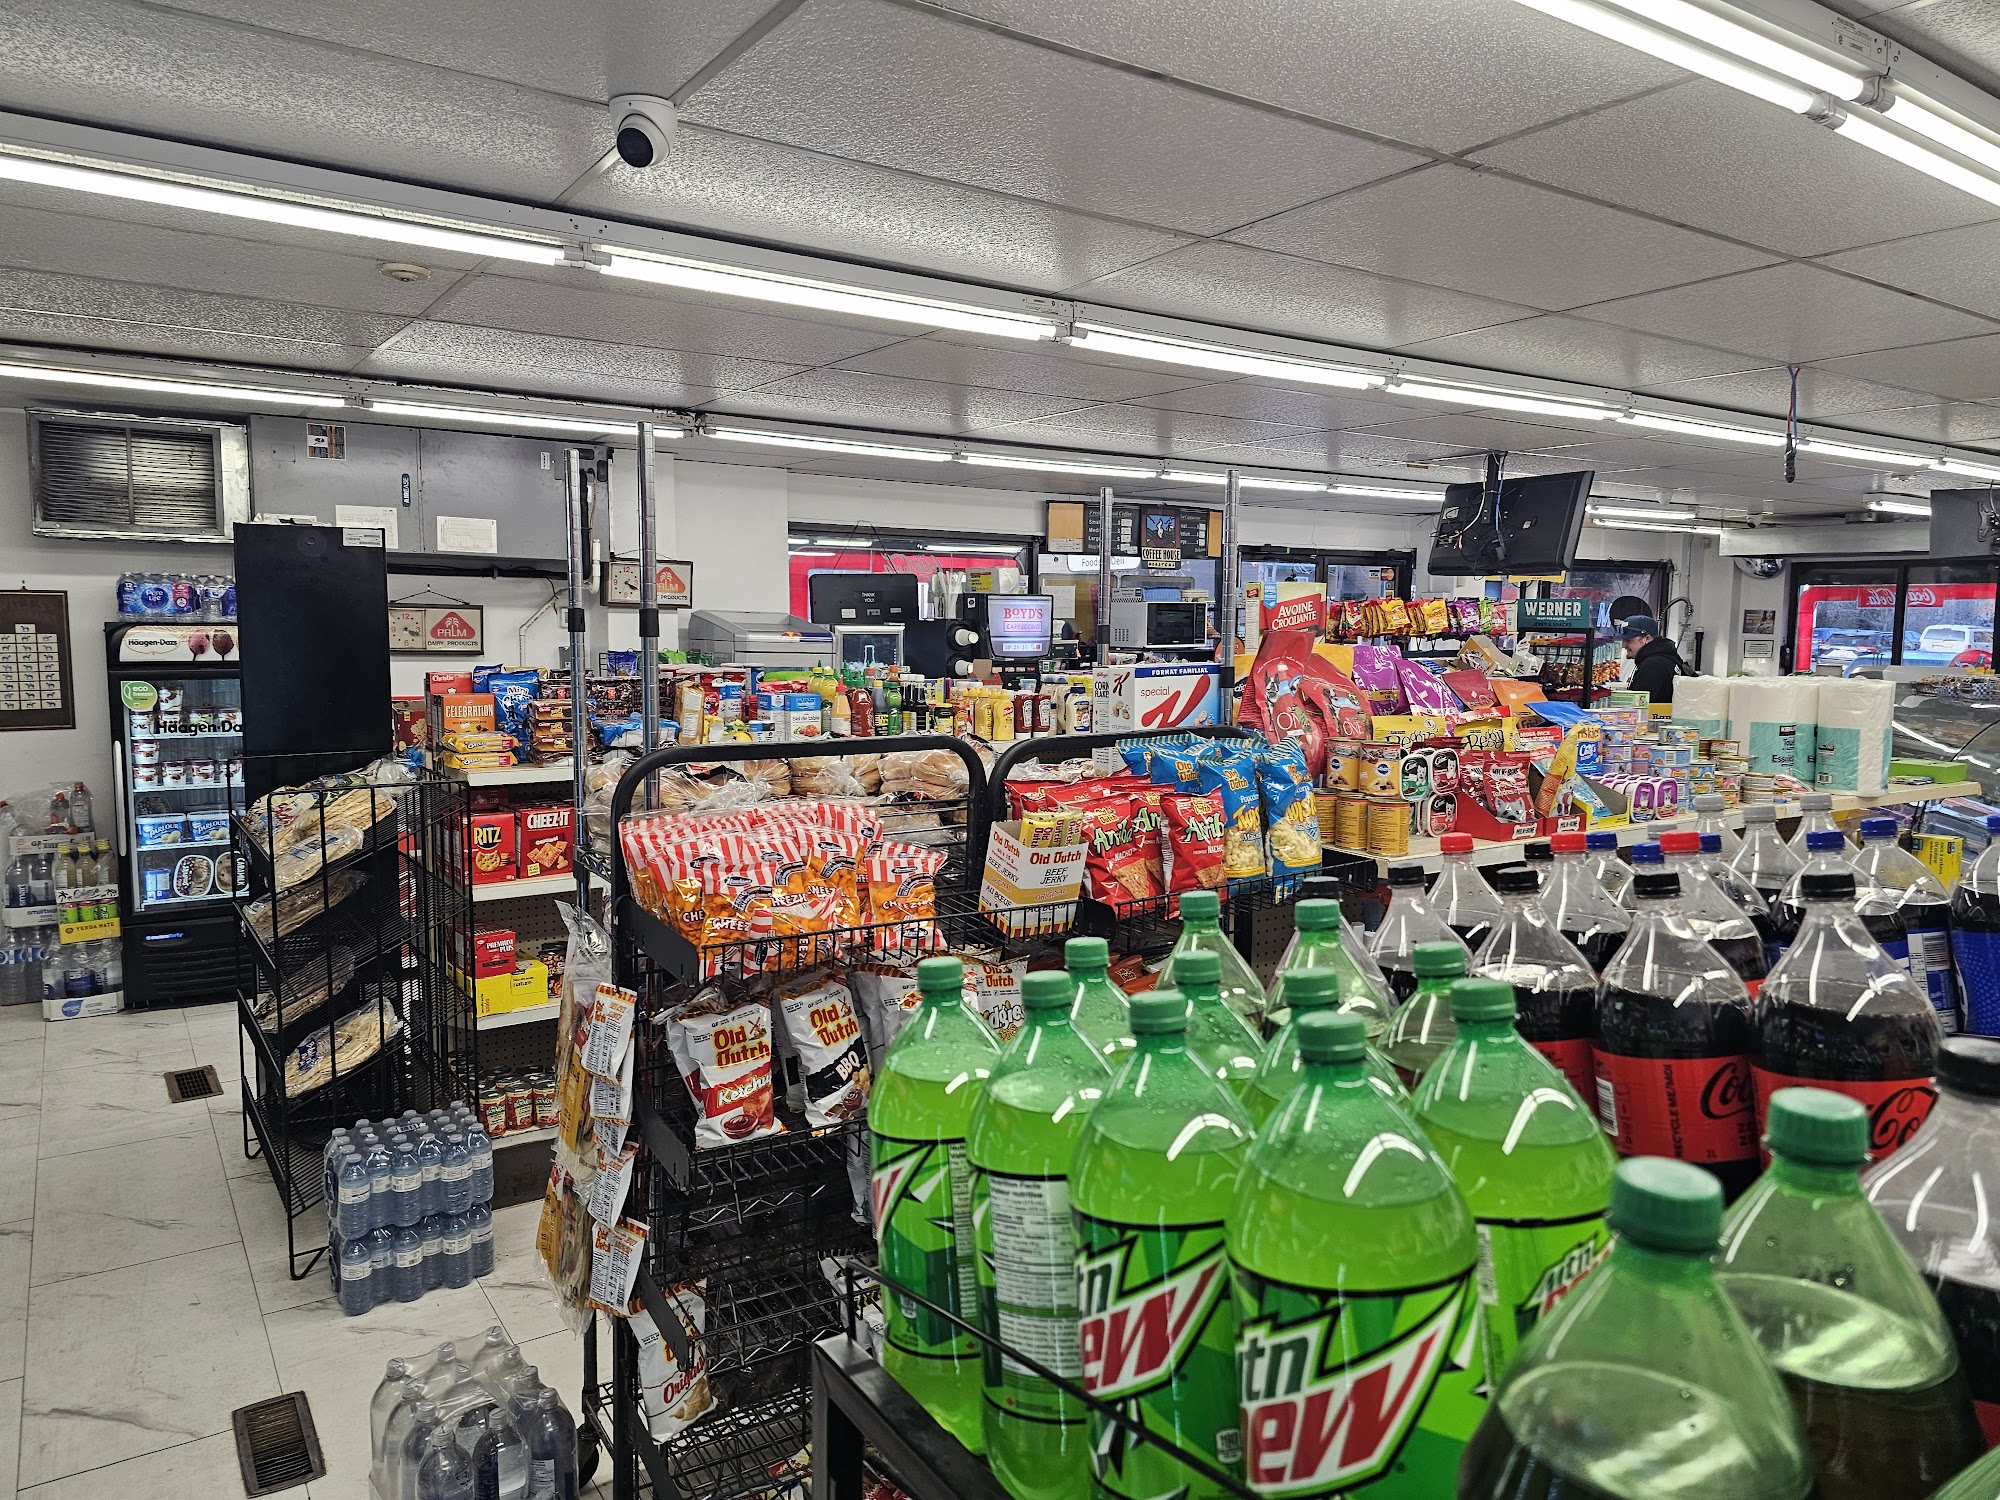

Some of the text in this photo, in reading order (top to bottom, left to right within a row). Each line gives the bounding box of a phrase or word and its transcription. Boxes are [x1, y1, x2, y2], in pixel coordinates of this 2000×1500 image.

[1111, 556, 1125, 566] Deli
[1142, 548, 1180, 560] COFFEE HOUSE
[1003, 607, 1043, 619] BOYD'S
[1277, 600, 1314, 619] AVOINE
[1524, 601, 1582, 616] WERNER
[401, 612, 410, 620] 12
[1271, 610, 1317, 631] CROQUANTE
[437, 626, 467, 637] PALM
[128, 638, 178, 648] Häagen-Dazs
[403, 639, 410, 647] 6
[432, 674, 455, 682] Christie
[1151, 666, 1209, 676] FORMAT FAMILIAL
[508, 685, 529, 695] Mini
[1112, 671, 1131, 697] K
[1140, 686, 1170, 699] special
[1141, 674, 1211, 728] K
[445, 704, 494, 718] CELEBRATION
[1342, 720, 1364, 736] ONE
[1176, 761, 1193, 772] Old
[1229, 777, 1249, 791] Dutch
[526, 811, 571, 829] CHEEZ-IT
[1099, 814, 1119, 825] Dutch
[150, 822, 180, 838] PARLOUR
[198, 820, 228, 834] PARLOUR
[473, 826, 502, 845] RITZ
[1093, 820, 1134, 854] Arriba
[993, 831, 1020, 858] Old Dutch
[1029, 850, 1082, 865] Old Dutch
[1115, 849, 1133, 861] NACHO
[988, 856, 1020, 883] BEEF JERKY
[1045, 867, 1068, 877] BEEF
[989, 875, 1012, 892] ORIGINAL
[1040, 874, 1069, 885] JERKY
[1034, 887, 1068, 902] ORIGINAL
[76, 921, 115, 932] YERBA MATE
[486, 939, 513, 949] PREMIUM
[499, 945, 514, 953] PLUS
[985, 974, 1015, 988] Dutch
[810, 1004, 840, 1028] Old
[713, 1025, 747, 1050] Old
[818, 1018, 858, 1046] Dutch
[716, 1040, 771, 1067] Dutch
[836, 1050, 861, 1081] BBQ
[1663, 1063, 1684, 1158] RECYCLE ME/MOI
[1241, 1335, 1310, 1401] tn
[1240, 1329, 1439, 1485] ew
